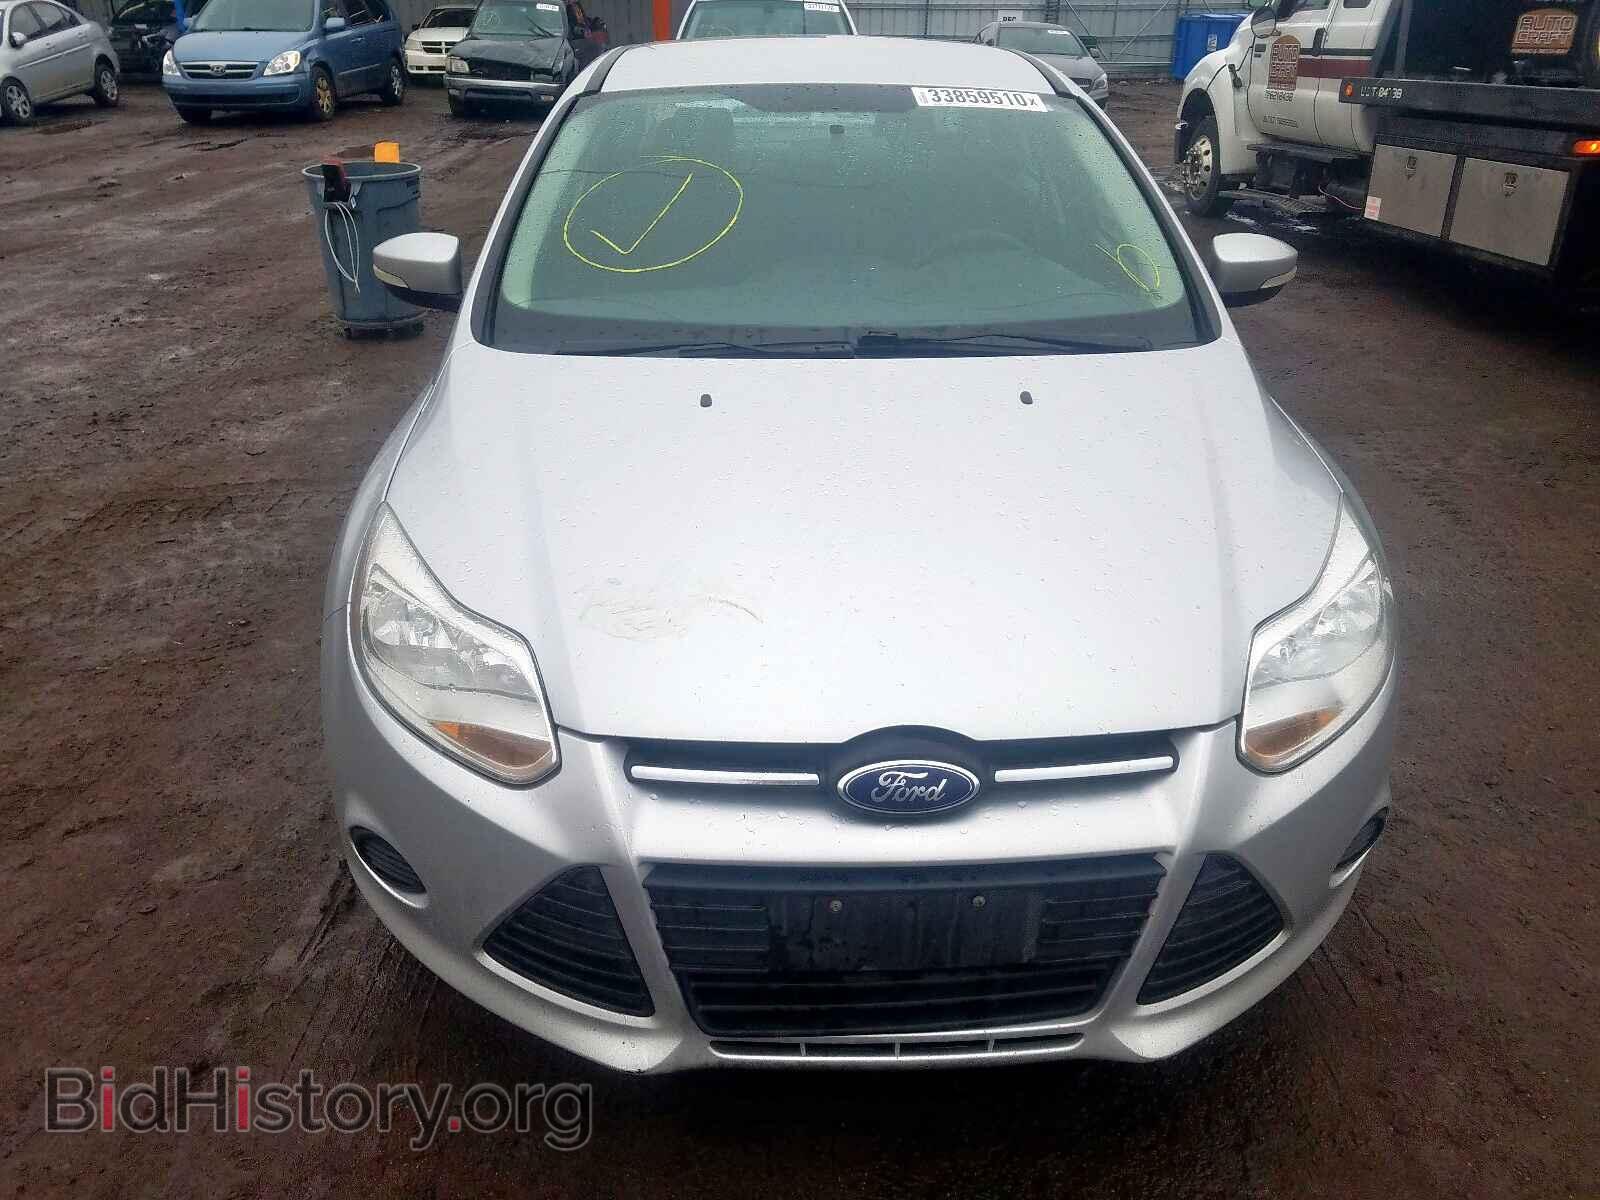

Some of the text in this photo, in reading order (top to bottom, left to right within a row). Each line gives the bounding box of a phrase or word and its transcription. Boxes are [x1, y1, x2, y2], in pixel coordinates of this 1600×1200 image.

[1517, 15, 1576, 32] AUTO
[1514, 31, 1571, 47] CRAFT
[870, 771, 949, 802] Ford
